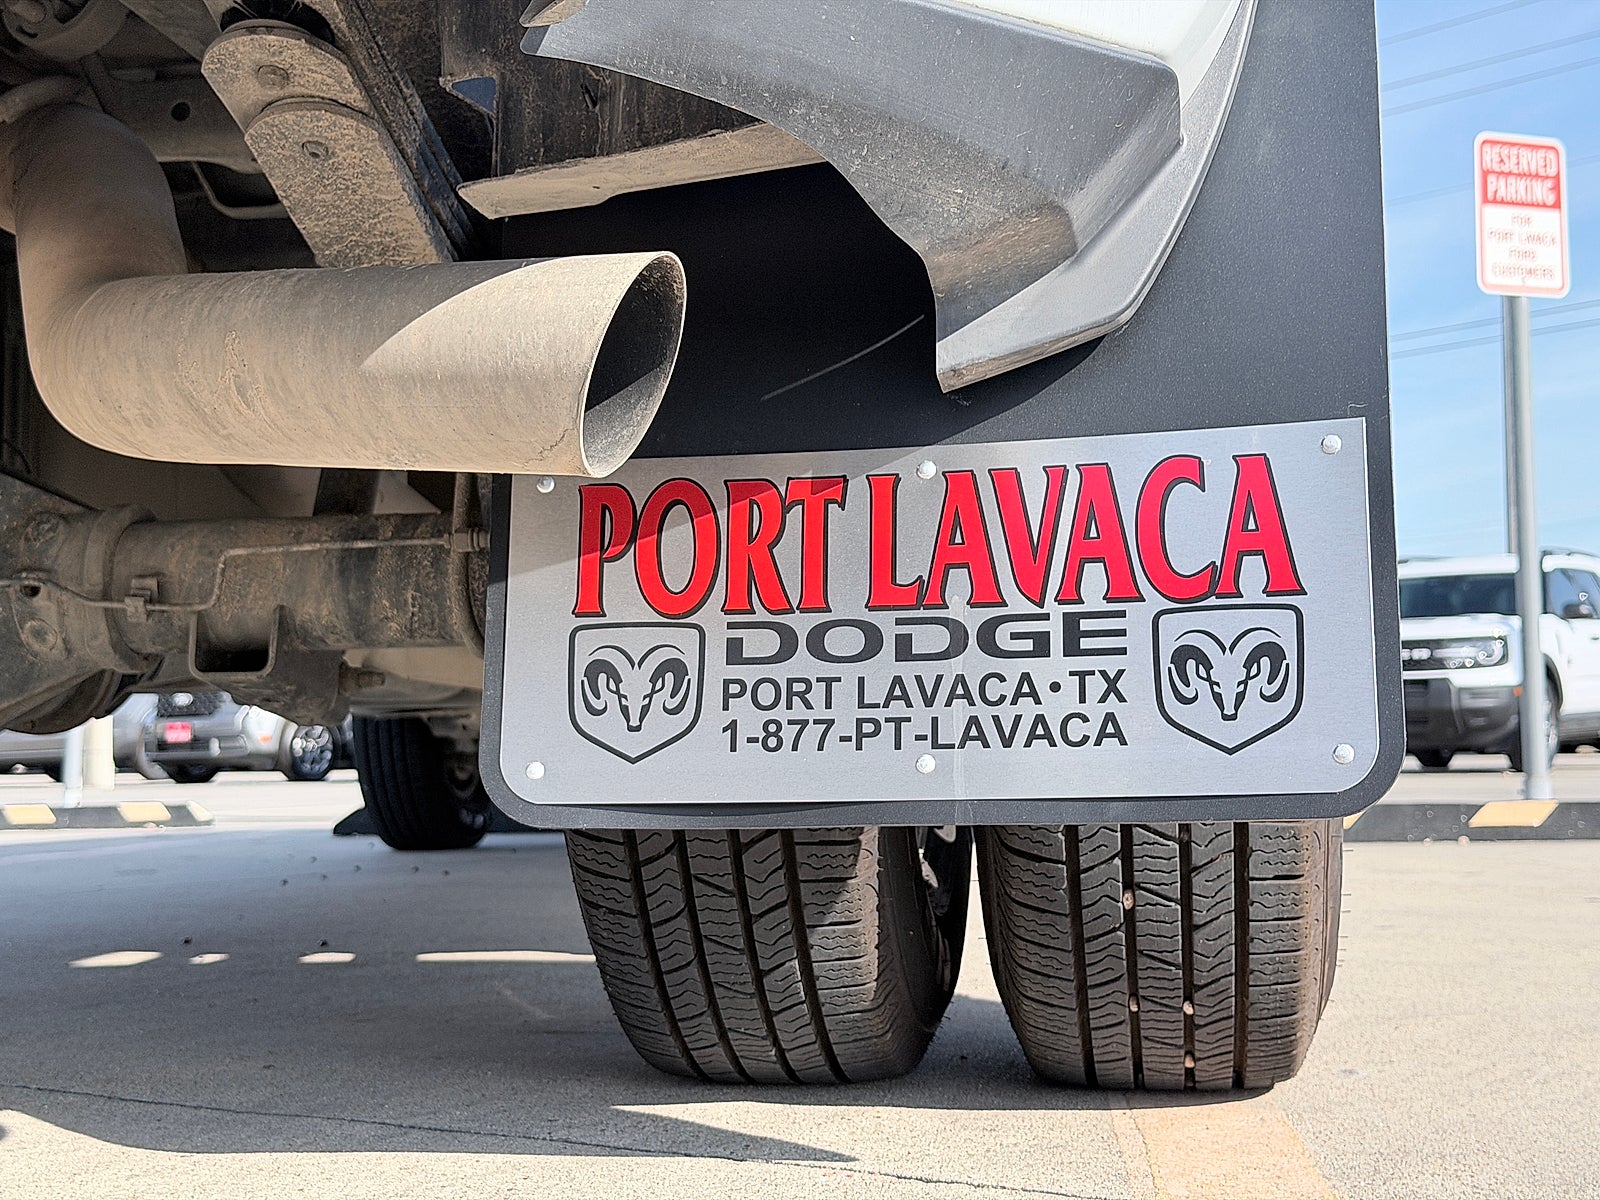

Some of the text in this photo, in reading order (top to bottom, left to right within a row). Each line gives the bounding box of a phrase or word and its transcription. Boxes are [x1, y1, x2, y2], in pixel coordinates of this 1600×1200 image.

[1482, 143, 1558, 176] RESERVED
[1486, 174, 1556, 206] PARKING
[571, 453, 1307, 618] PORT LAVACA
[725, 610, 1127, 666] DODGE
[722, 676, 843, 712] PORT
[722, 711, 1128, 753] 1-877-PT-LAVACA
